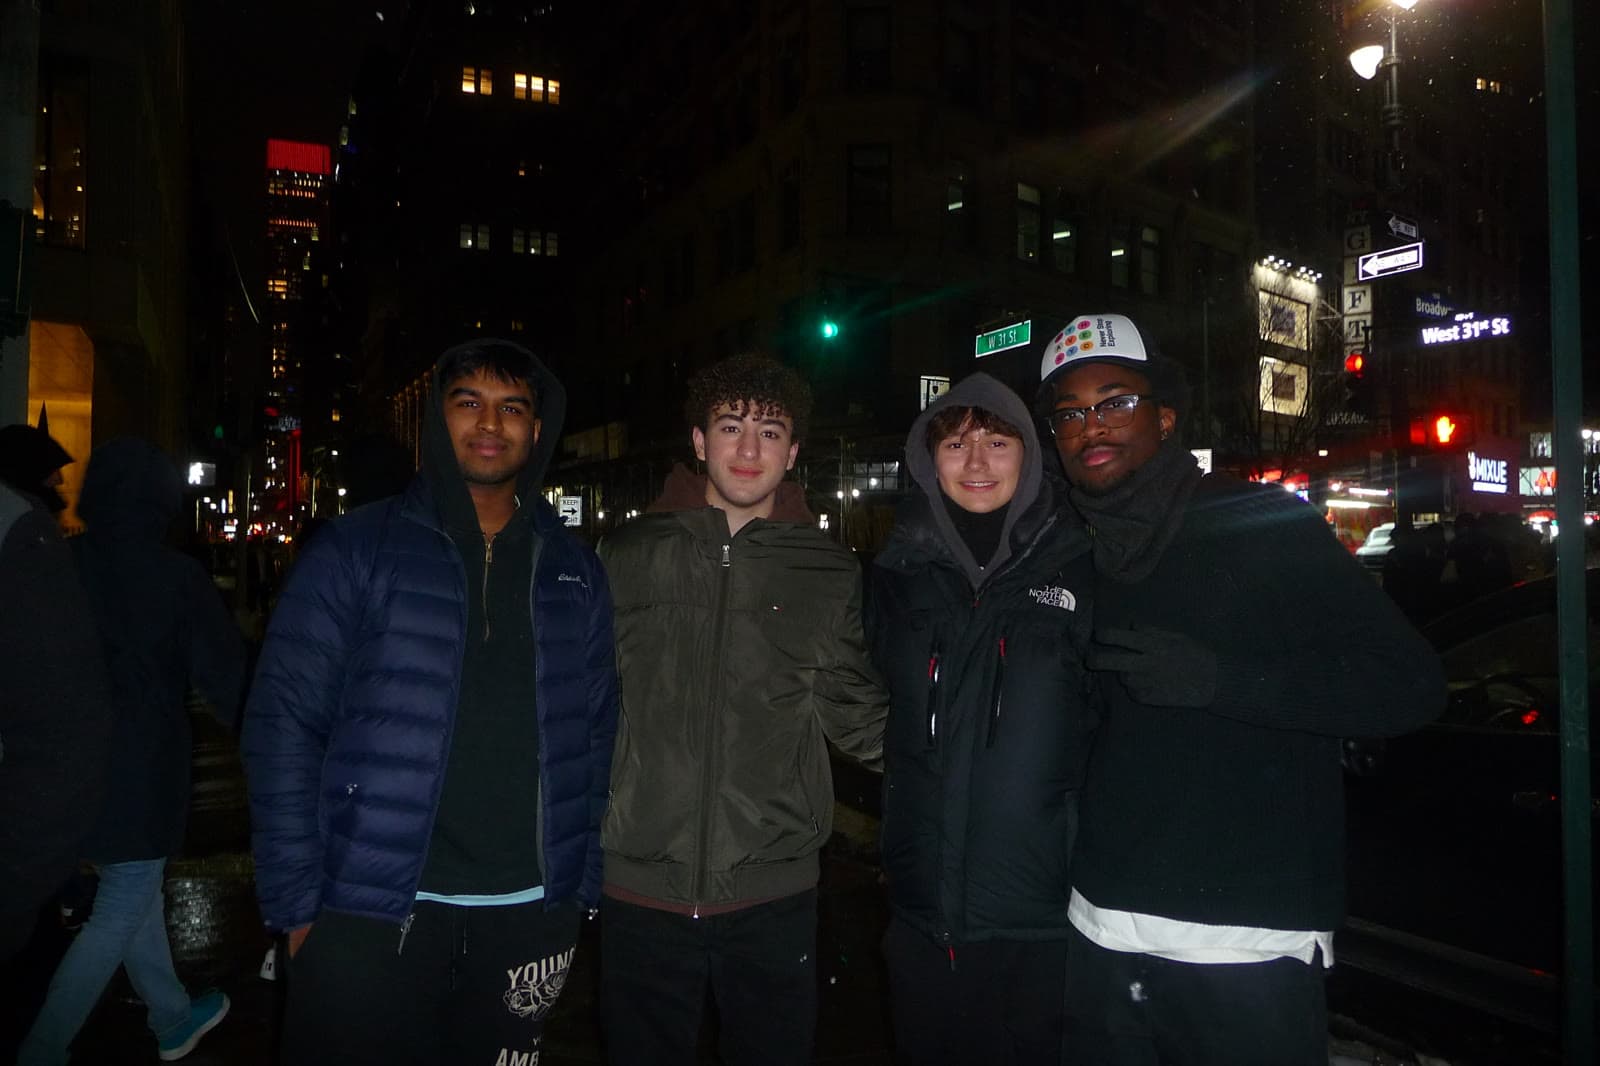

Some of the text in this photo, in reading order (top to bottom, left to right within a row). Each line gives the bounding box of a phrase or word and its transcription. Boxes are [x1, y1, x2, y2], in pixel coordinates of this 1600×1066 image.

[1415, 297, 1453, 317] Broadw
[988, 328, 1017, 349] W 31 St
[1422, 317, 1510, 344] West 31st St
[1477, 457, 1507, 483] MIXUE
[1028, 588, 1061, 600] NORTH
[1036, 596, 1060, 607] FACE
